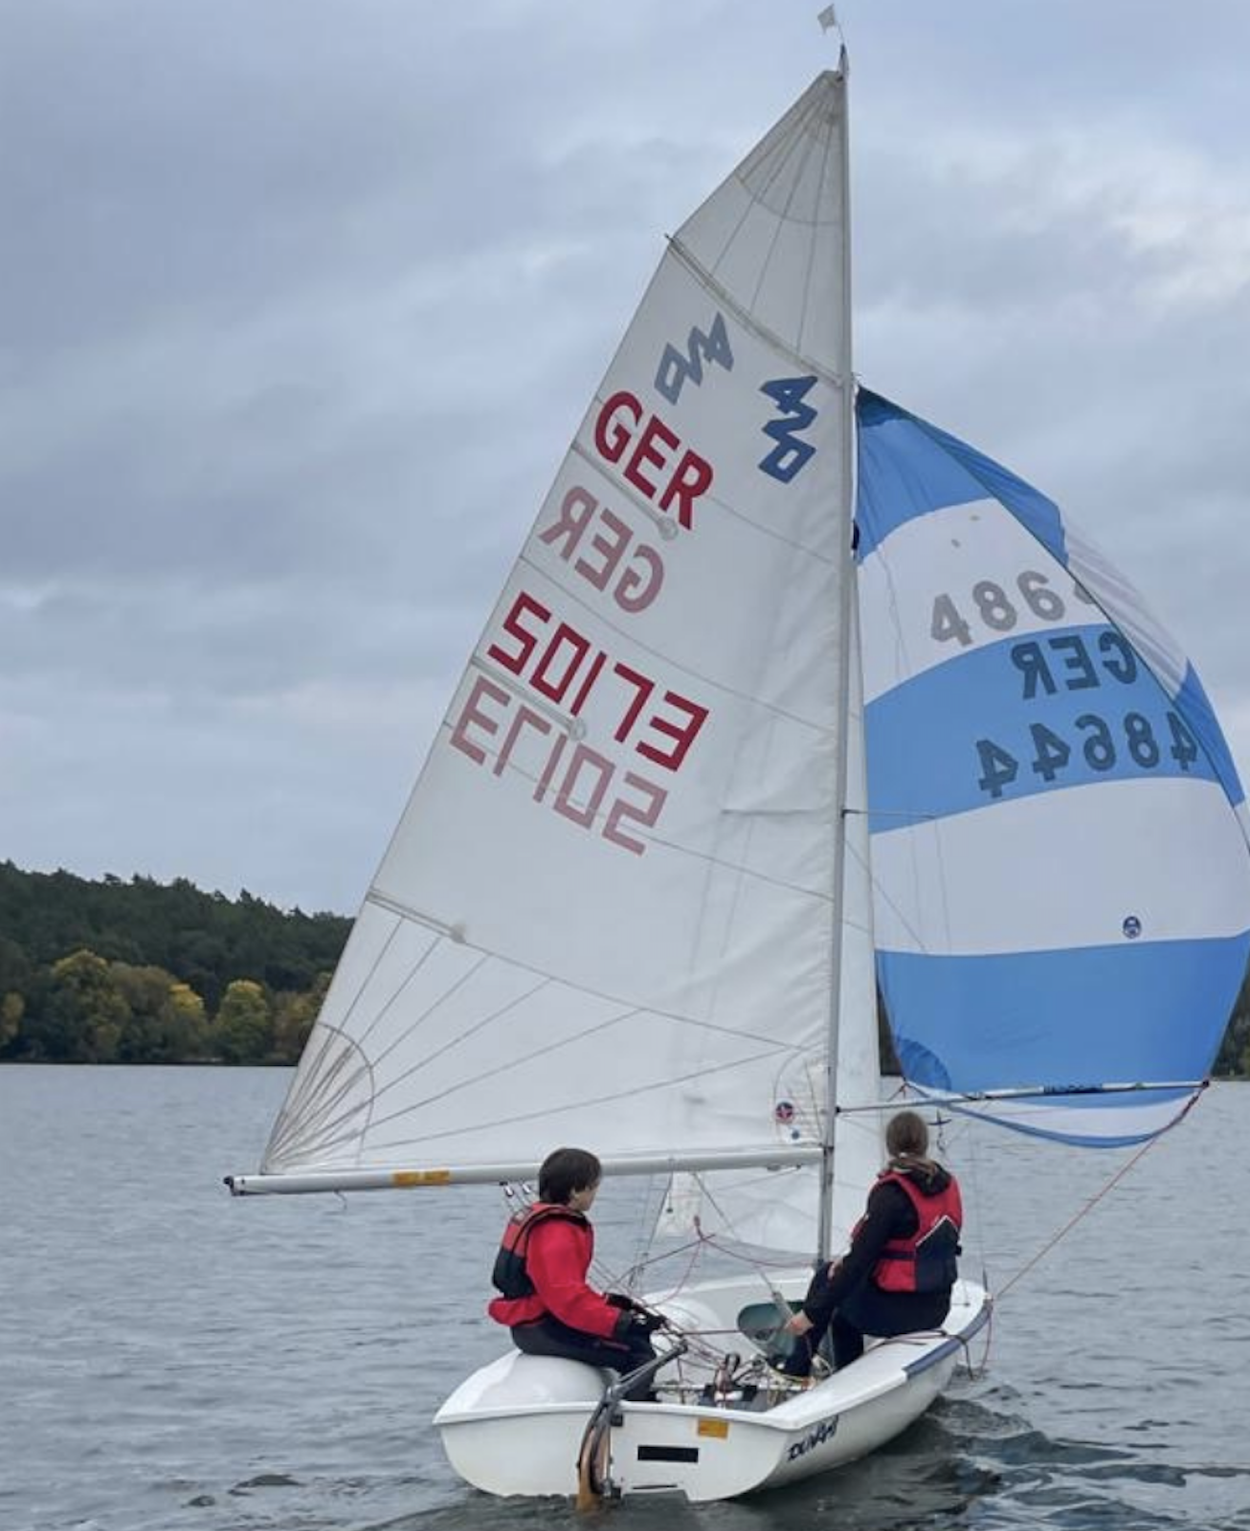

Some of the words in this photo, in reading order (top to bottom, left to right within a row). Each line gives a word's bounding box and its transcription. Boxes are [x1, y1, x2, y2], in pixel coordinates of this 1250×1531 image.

[595, 391, 713, 530] GER
[930, 570, 1099, 647] 486
[486, 591, 709, 772] 50173
